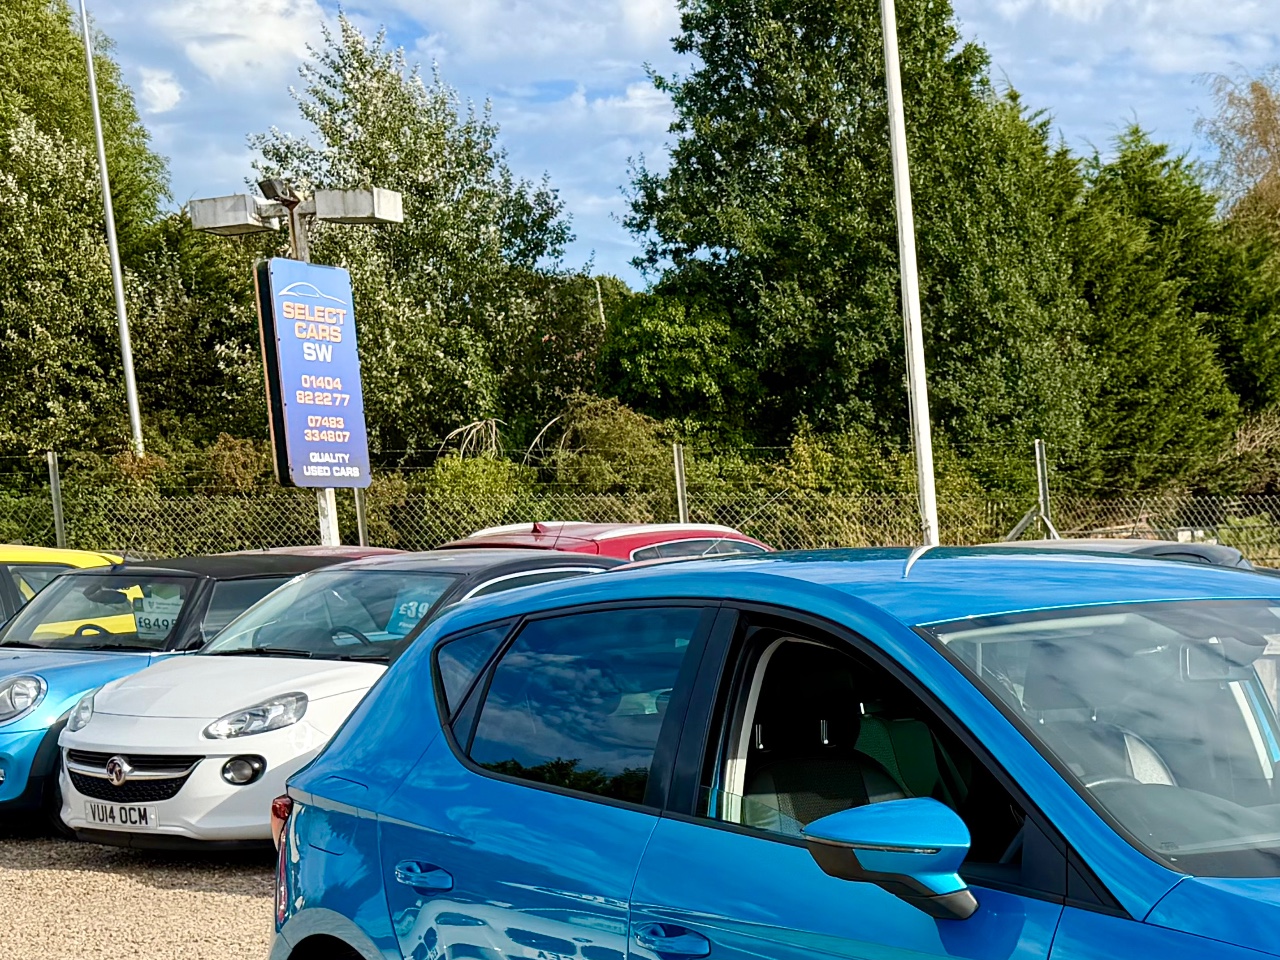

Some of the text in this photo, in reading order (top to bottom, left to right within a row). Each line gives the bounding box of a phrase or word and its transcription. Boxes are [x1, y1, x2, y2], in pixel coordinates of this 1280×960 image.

[282, 301, 347, 326] SELECT
[294, 322, 342, 343] CARS
[303, 342, 333, 363] SW
[301, 374, 342, 391] 01404
[304, 428, 350, 443] 334807
[309, 451, 350, 464] QUALITY
[303, 465, 360, 478] USED CARS
[398, 601, 430, 619] £39
[90, 803, 149, 826] VU14 OCM
